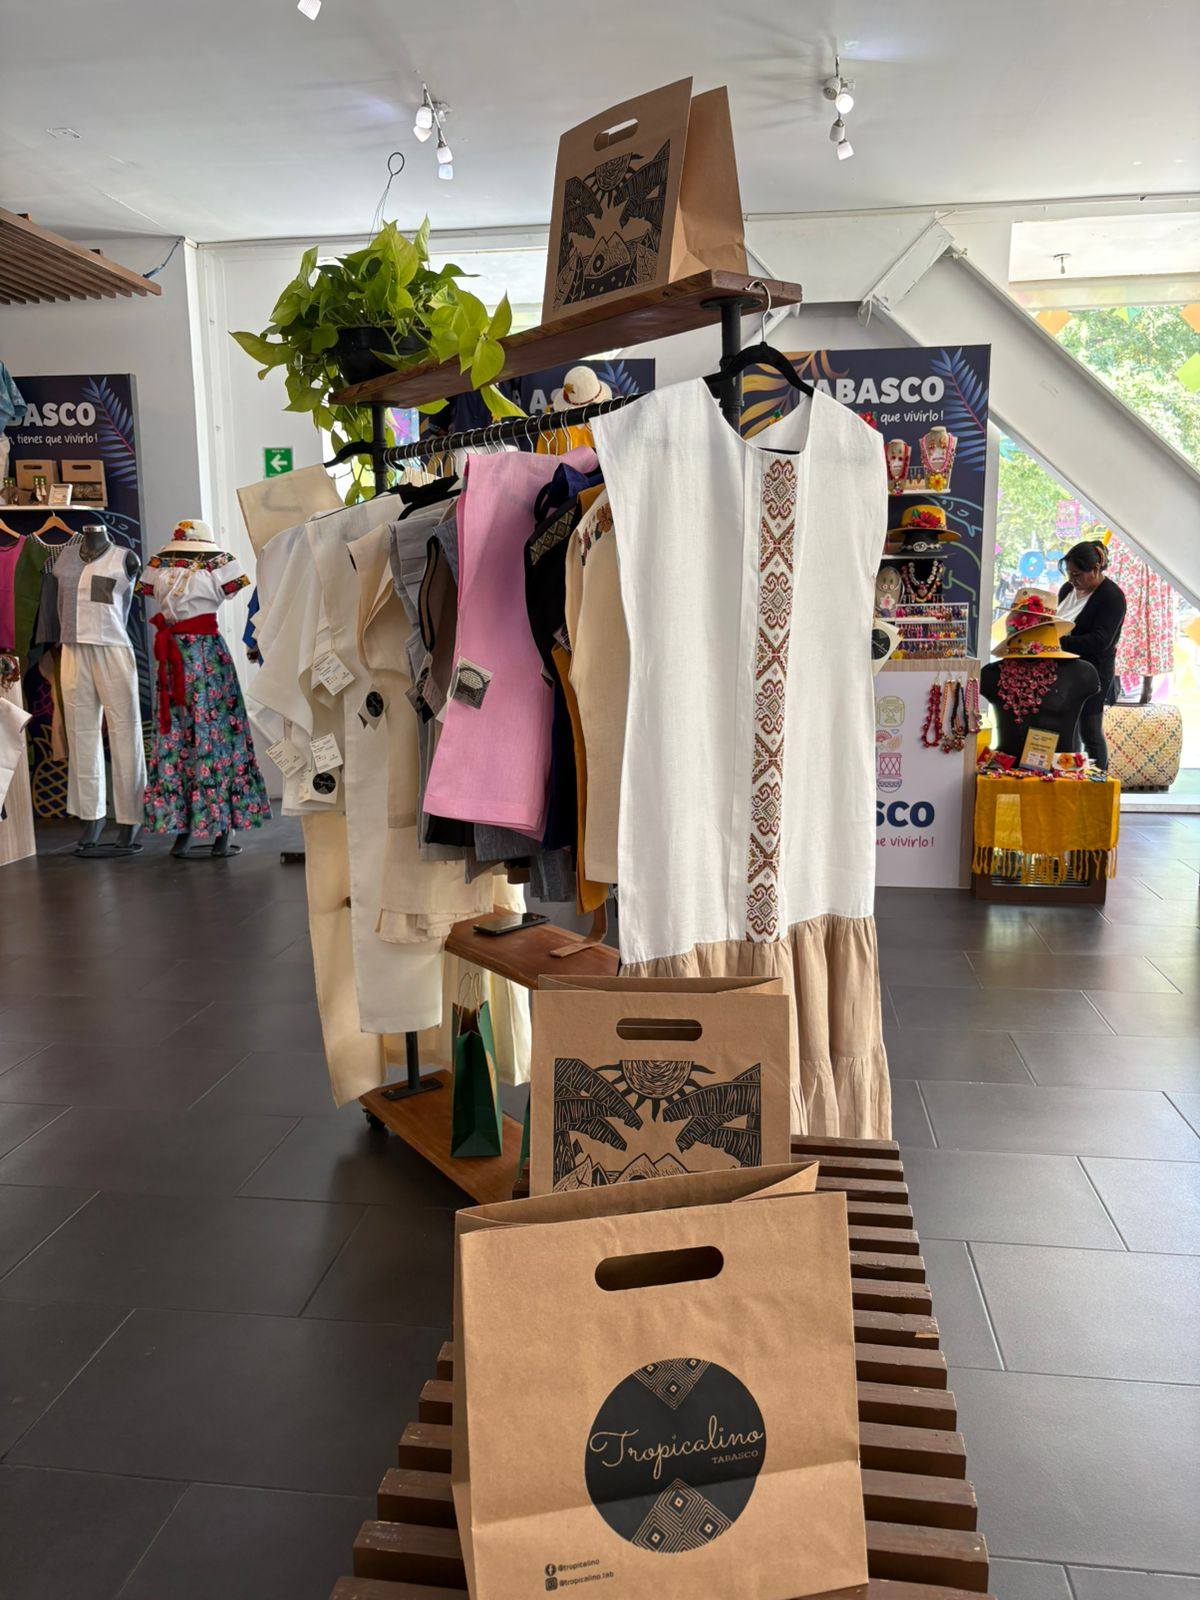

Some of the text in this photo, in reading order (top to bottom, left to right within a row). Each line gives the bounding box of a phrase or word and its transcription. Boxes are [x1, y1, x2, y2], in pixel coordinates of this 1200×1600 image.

[880, 412, 901, 425] que
[17, 433, 43, 444] tienes
[45, 435, 62, 446] que
[590, 1415, 763, 1480] Tropicalino
[712, 1450, 759, 1465] TABASCO
